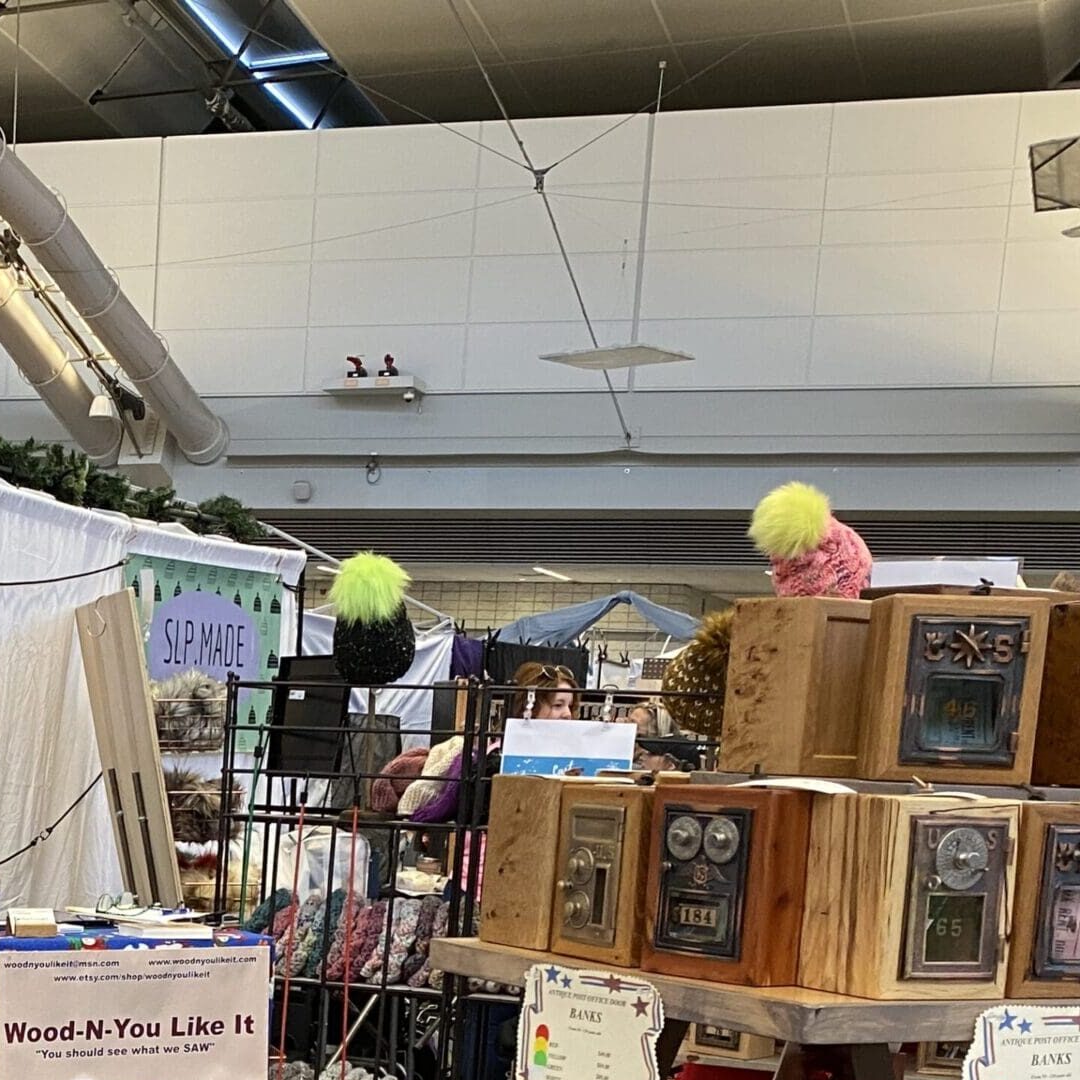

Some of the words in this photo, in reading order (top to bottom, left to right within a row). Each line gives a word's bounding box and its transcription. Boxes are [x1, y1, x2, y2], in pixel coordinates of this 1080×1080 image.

[163, 617, 246, 668] SLP.MADE
[683, 908, 713, 924] 184
[936, 918, 962, 937] 65
[569, 1007, 603, 1024] BANKS
[4, 1018, 160, 1044] Wood-N-You
[171, 1016, 225, 1037] Like
[235, 1014, 254, 1035] It
[1001, 1036, 1032, 1047] ANTIQUE
[1033, 1036, 1052, 1045] POST
[65, 1047, 104, 1058] should
[107, 1048, 128, 1056] see
[131, 1045, 159, 1055] what
[163, 1046, 180, 1054] we
[1031, 1053, 1072, 1066] BANKS
